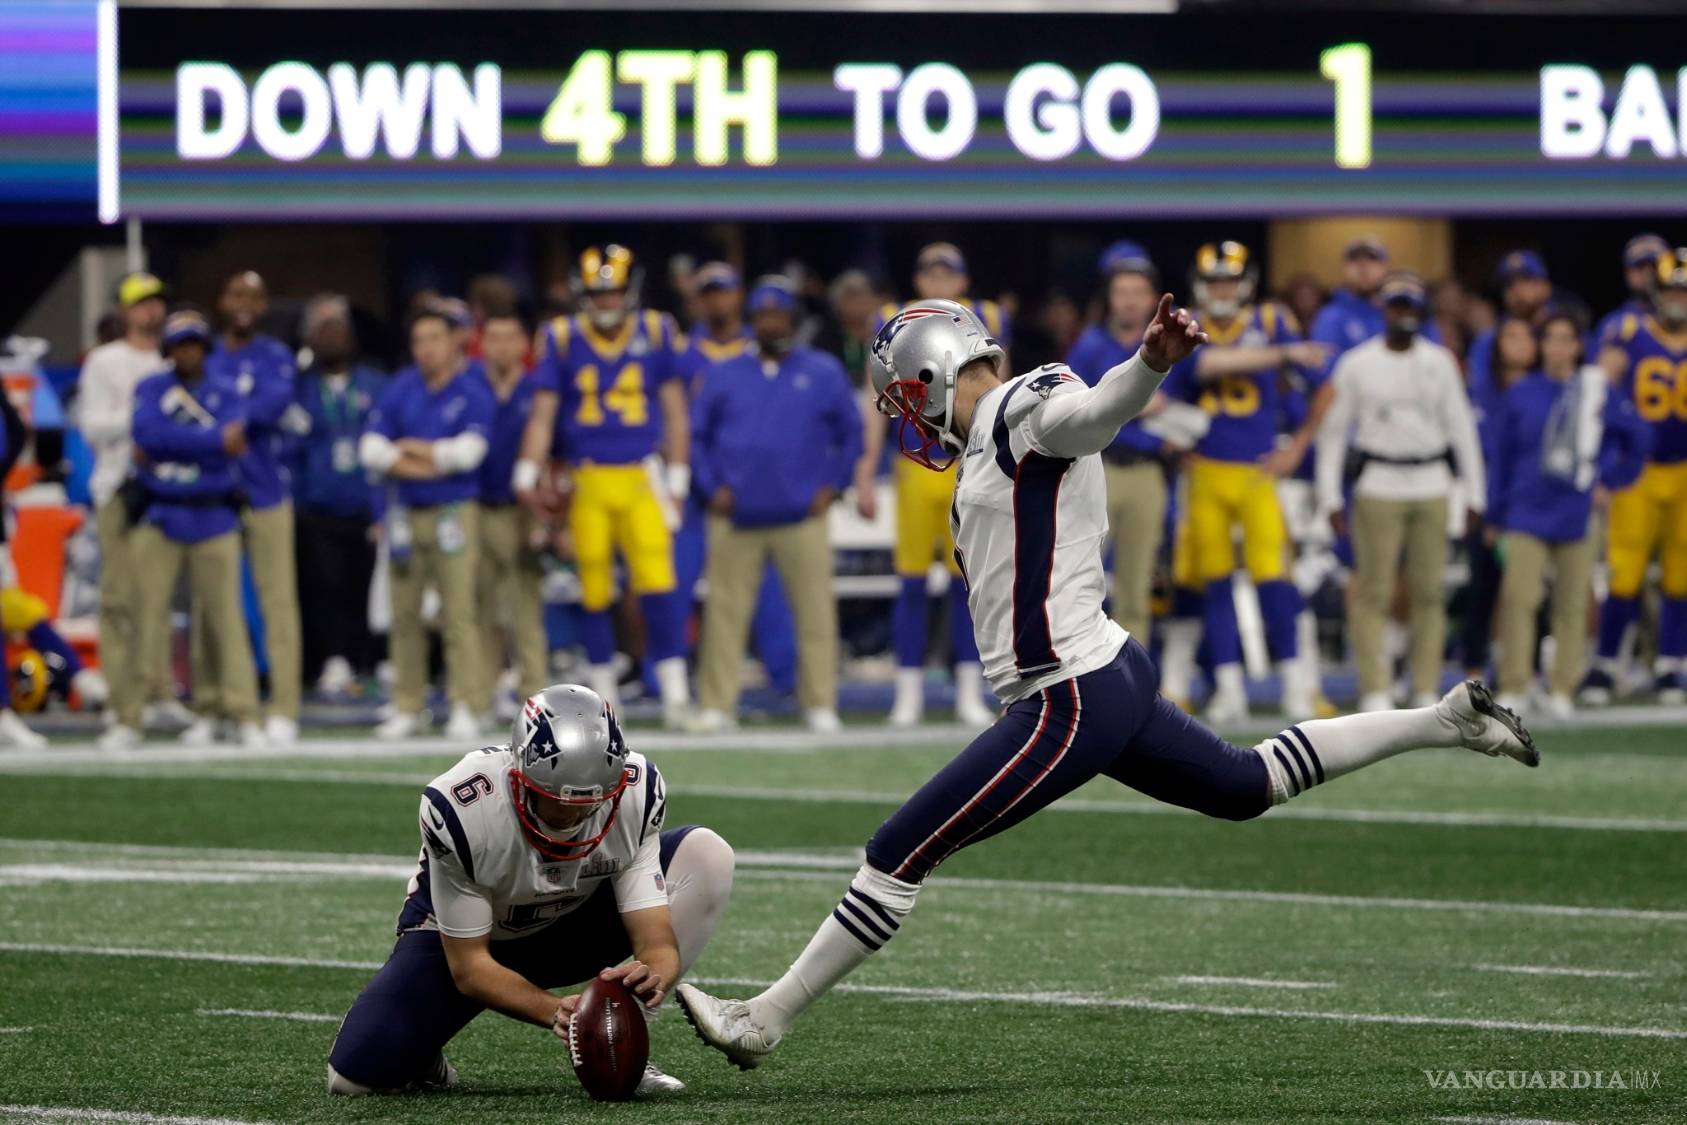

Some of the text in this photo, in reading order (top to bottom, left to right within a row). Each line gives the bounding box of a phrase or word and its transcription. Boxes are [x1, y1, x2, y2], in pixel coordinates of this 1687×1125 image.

[175, 42, 1687, 169] DOWN 4TH TO GO 1 BA
[575, 362, 648, 427] 14
[451, 771, 494, 807] 6
